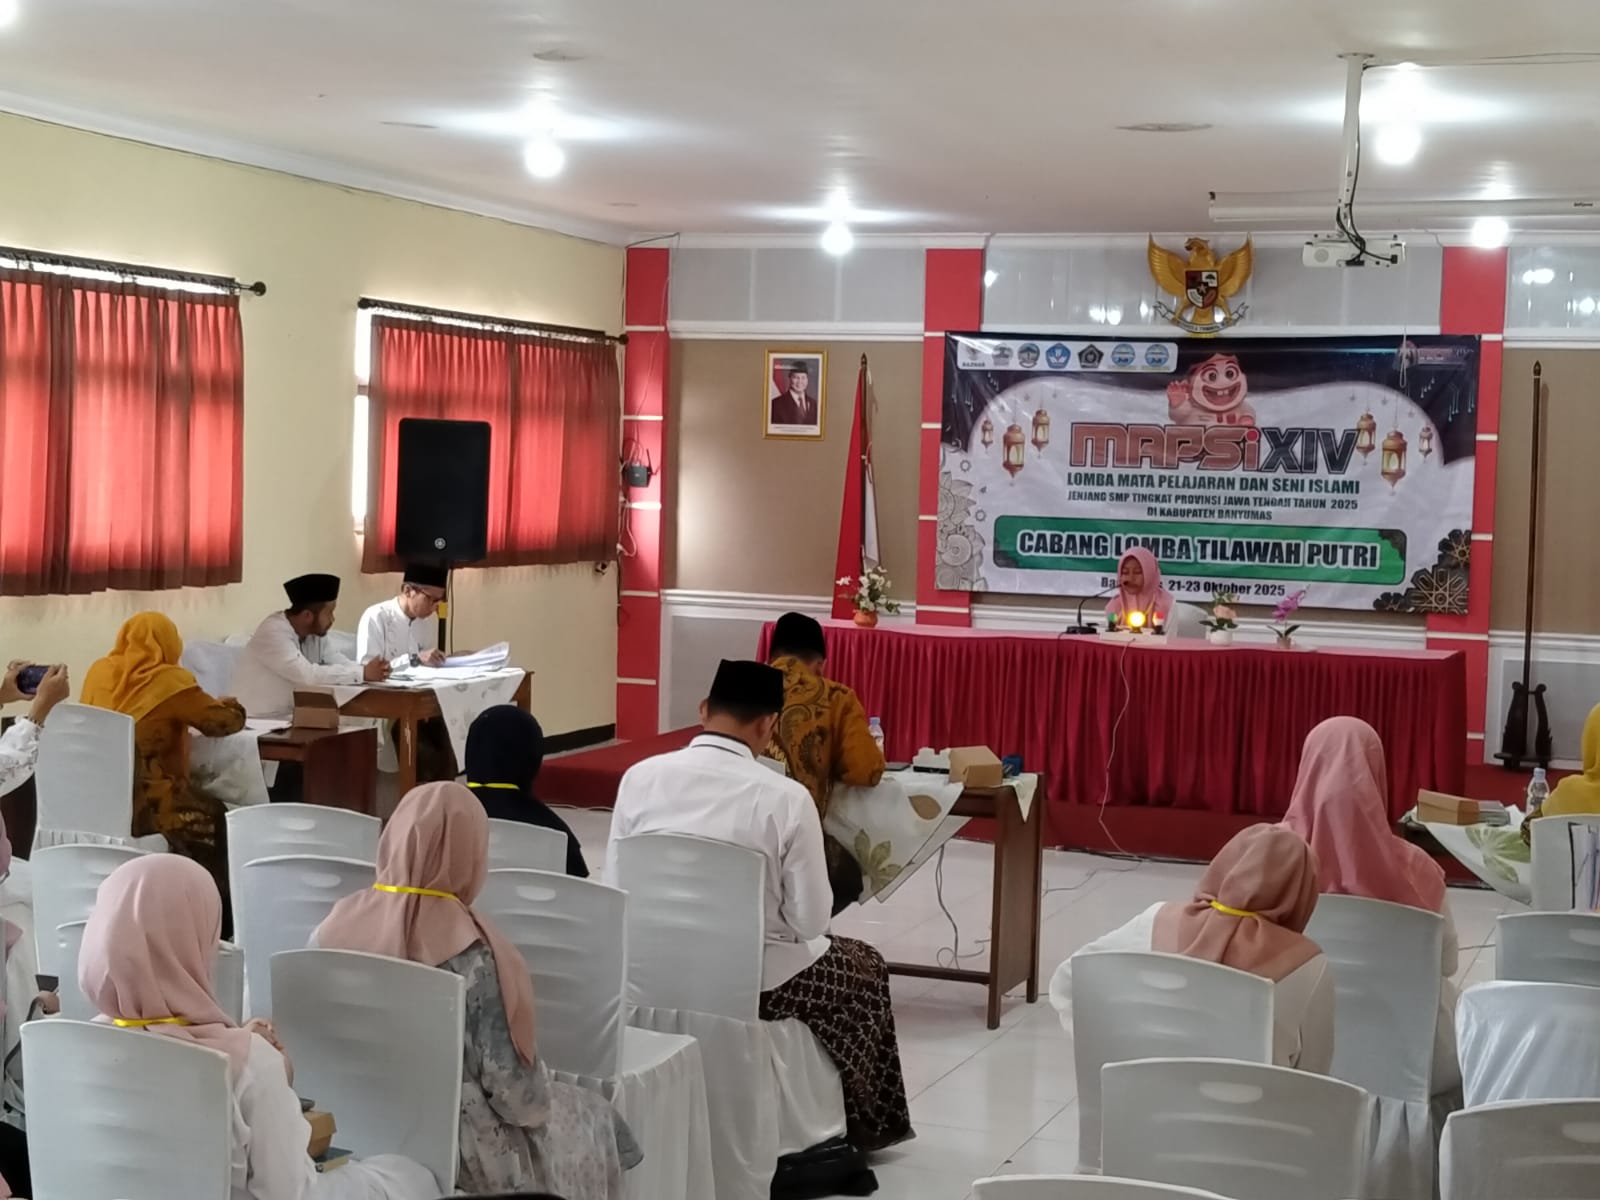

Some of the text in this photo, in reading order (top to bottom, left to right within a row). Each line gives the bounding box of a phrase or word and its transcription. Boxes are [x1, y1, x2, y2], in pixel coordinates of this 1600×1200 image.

[1259, 427, 1361, 475] XIV
[1067, 472, 1360, 494] LOMBA MATA PELAJARAN DAN SENI ISLAMI
[1067, 491, 1358, 509] JENJANG SMP TINGKAT PROVINSI JAWA TENGAH TAHUN 2025
[1147, 506, 1273, 520] DI KABUPATEN BANYUMAS
[1018, 531, 1109, 557] CABANG
[1197, 538, 1301, 565] TILAWAH
[1307, 542, 1378, 568] PUTRI
[1168, 580, 1200, 593] 21-23
[1203, 581, 1251, 595] Oktober
[1254, 583, 1285, 596] 2025
